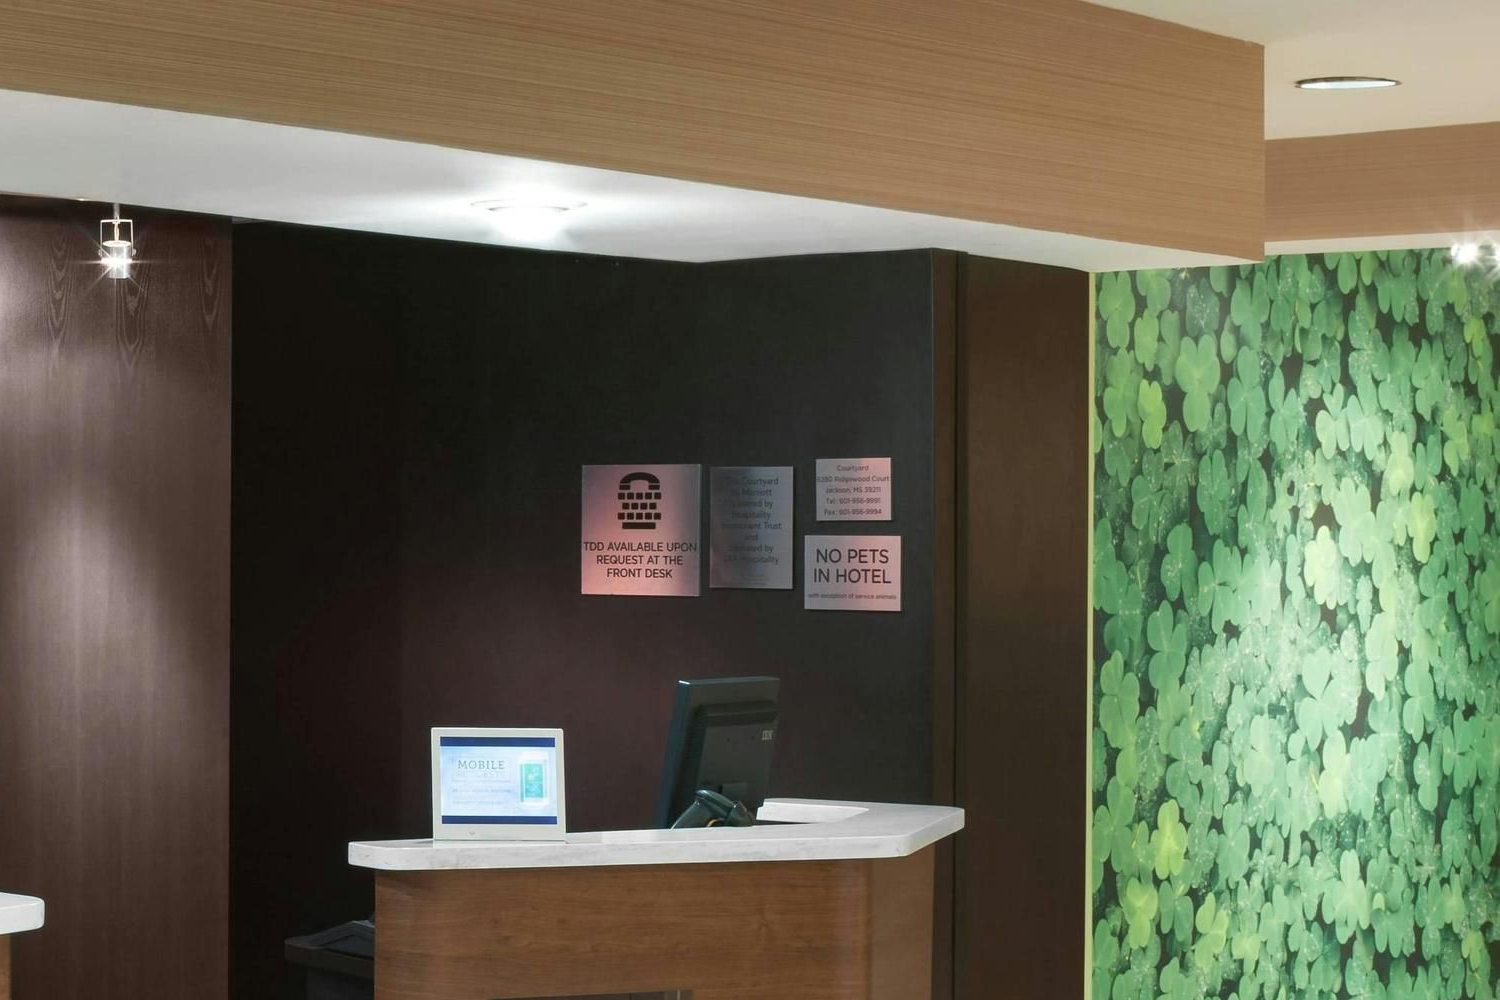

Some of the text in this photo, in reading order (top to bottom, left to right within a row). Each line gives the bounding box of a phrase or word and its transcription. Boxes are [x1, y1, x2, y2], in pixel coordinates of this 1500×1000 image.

[583, 541, 697, 552] TDD AVAILABLE UPON
[596, 555, 683, 565] REQUEST AT THE
[816, 549, 889, 563] NO PETS
[606, 568, 673, 578] FRONT DESK
[814, 568, 892, 584] IN HOTEL
[458, 760, 505, 769] MOBILE
